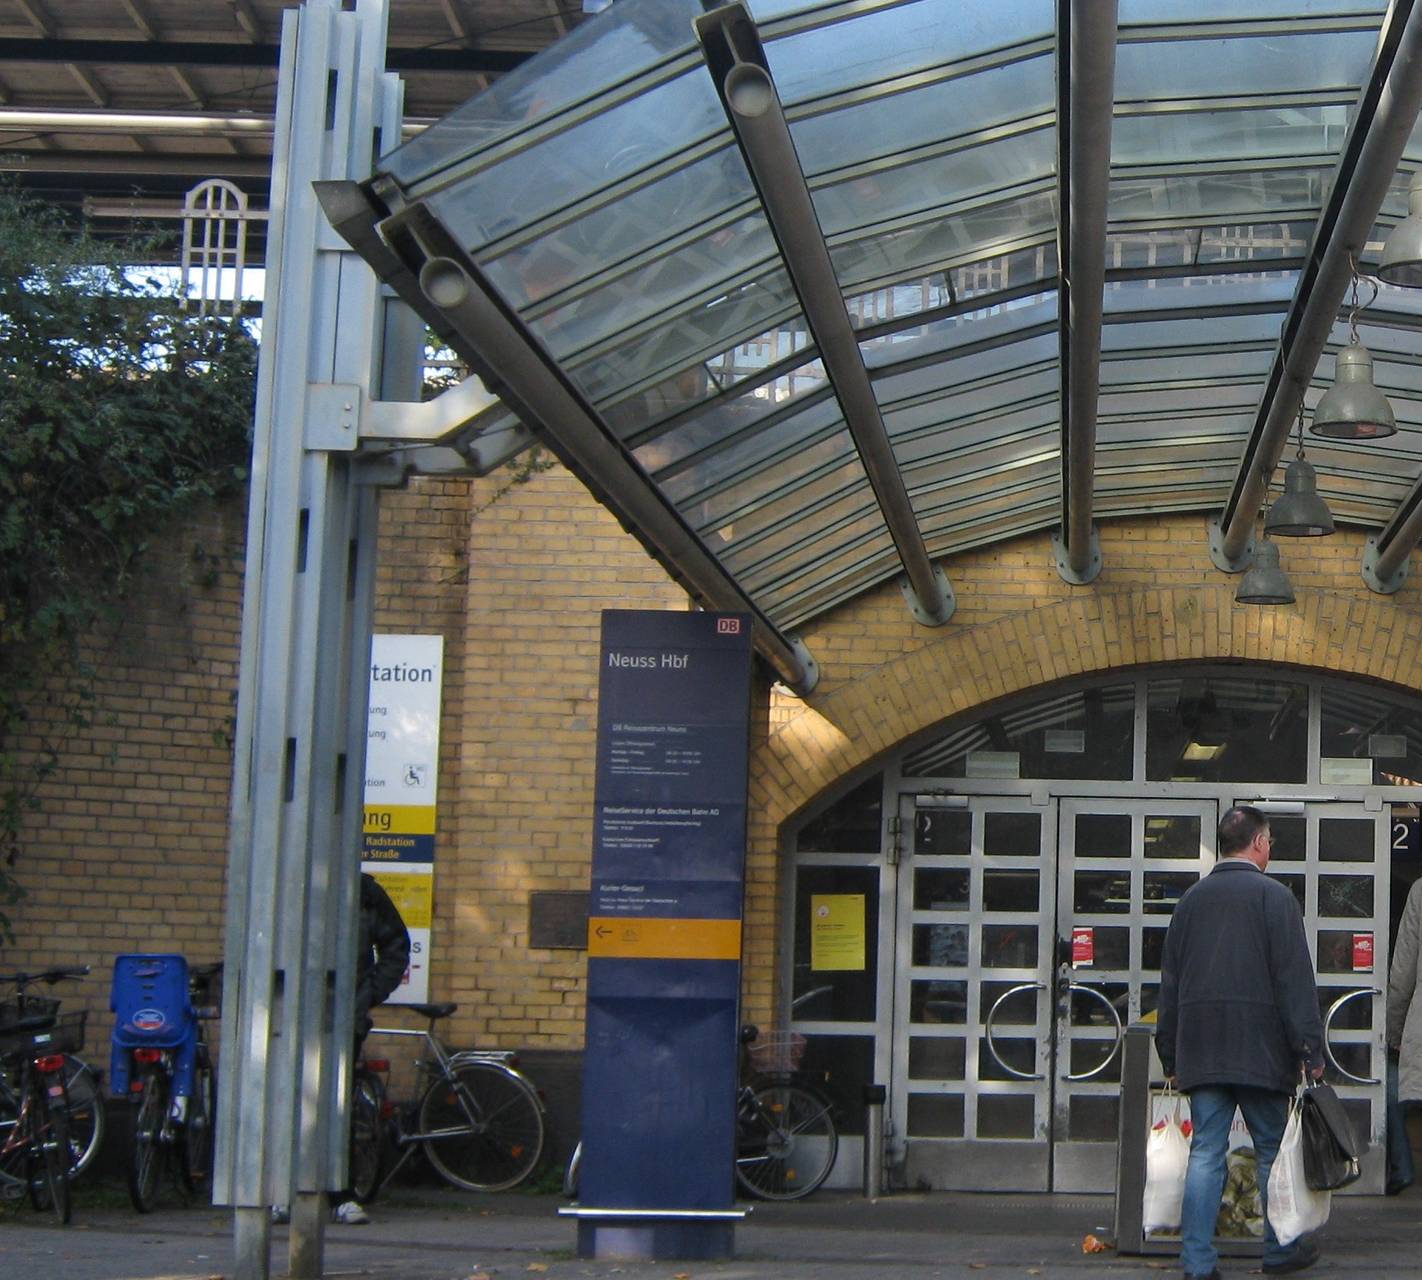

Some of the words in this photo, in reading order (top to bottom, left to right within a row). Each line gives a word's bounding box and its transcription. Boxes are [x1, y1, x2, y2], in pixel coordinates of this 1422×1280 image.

[719, 620, 738, 632] DB
[608, 653, 656, 668] Neuss
[661, 654, 689, 669] Hbf
[371, 662, 432, 682] tation
[369, 706, 387, 716] ung
[368, 730, 386, 740] ung
[366, 836, 416, 847] Radstation
[1392, 823, 1409, 849] 2
[370, 848, 400, 859] Straße
